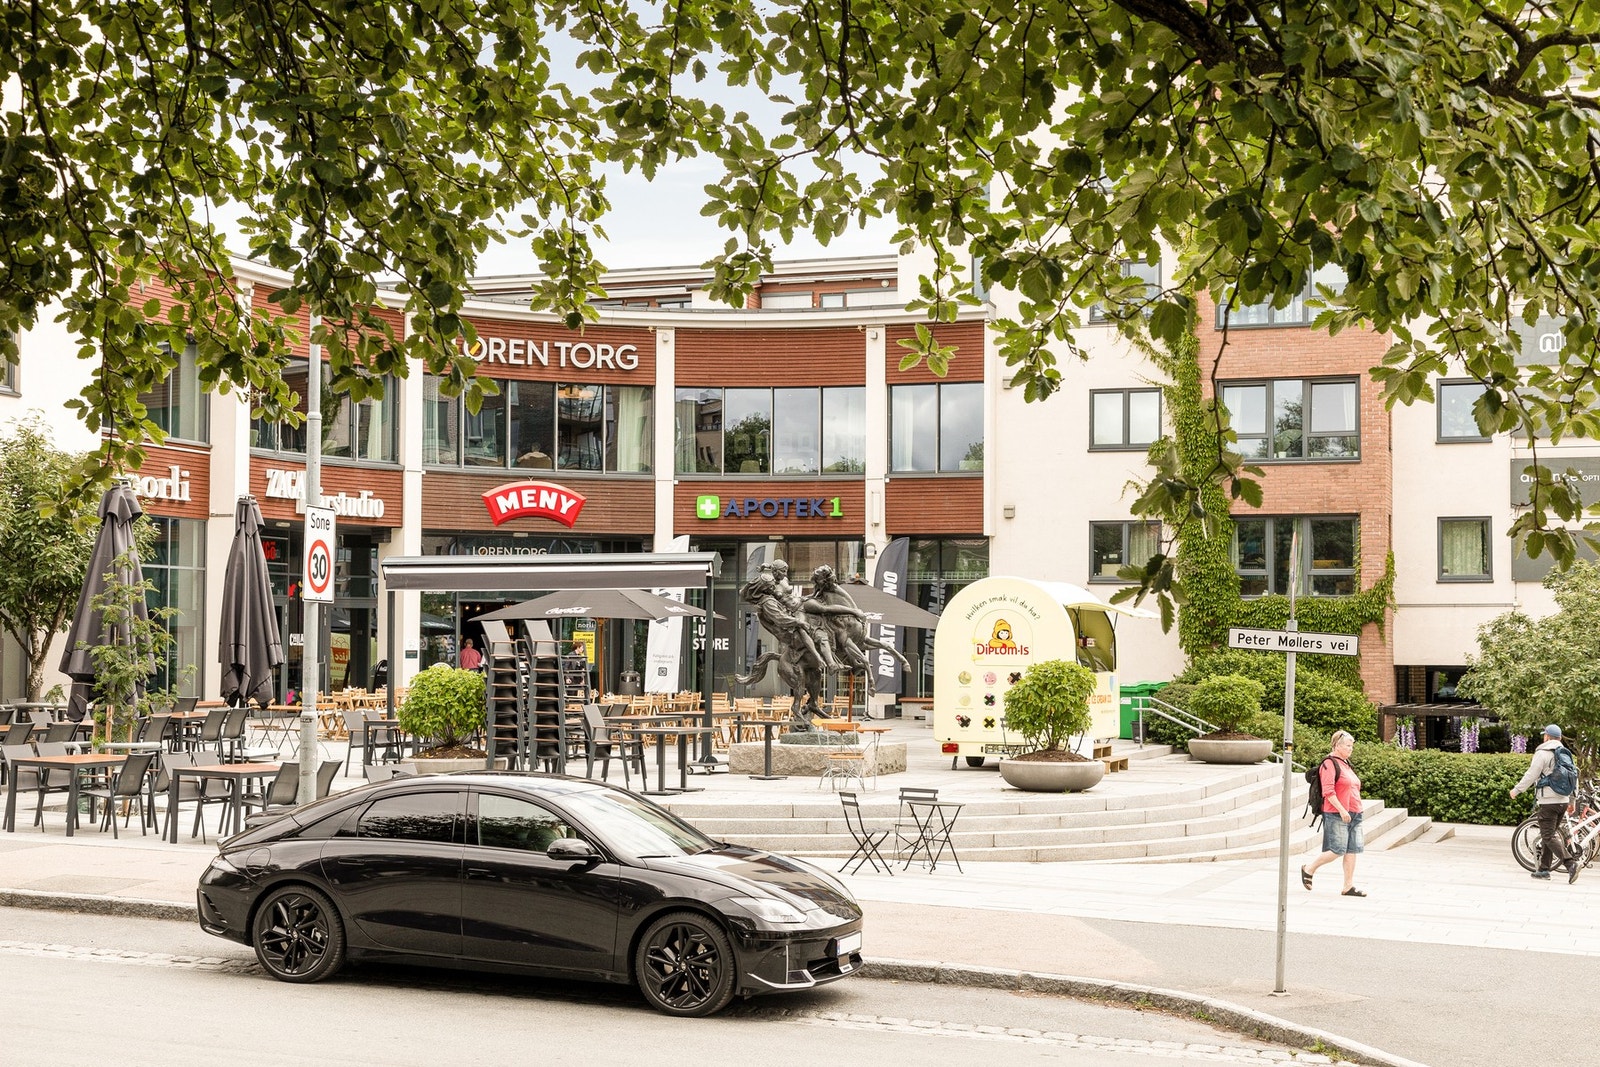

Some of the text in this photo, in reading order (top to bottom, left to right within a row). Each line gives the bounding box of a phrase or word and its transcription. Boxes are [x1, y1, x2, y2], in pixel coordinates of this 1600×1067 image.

[554, 341, 639, 370] TORG
[495, 489, 577, 514] MENY
[724, 497, 843, 517] APOTEK 1
[311, 512, 331, 531] Sone
[472, 546, 548, 556] LØREN TORG
[311, 553, 327, 580] 30
[965, 600, 987, 620] Hvilken
[988, 594, 1008, 603] smak
[1019, 600, 1028, 609] du
[1028, 606, 1041, 620] ha?
[693, 638, 729, 650] STRE
[1237, 633, 1349, 651] Peter Møllers vei
